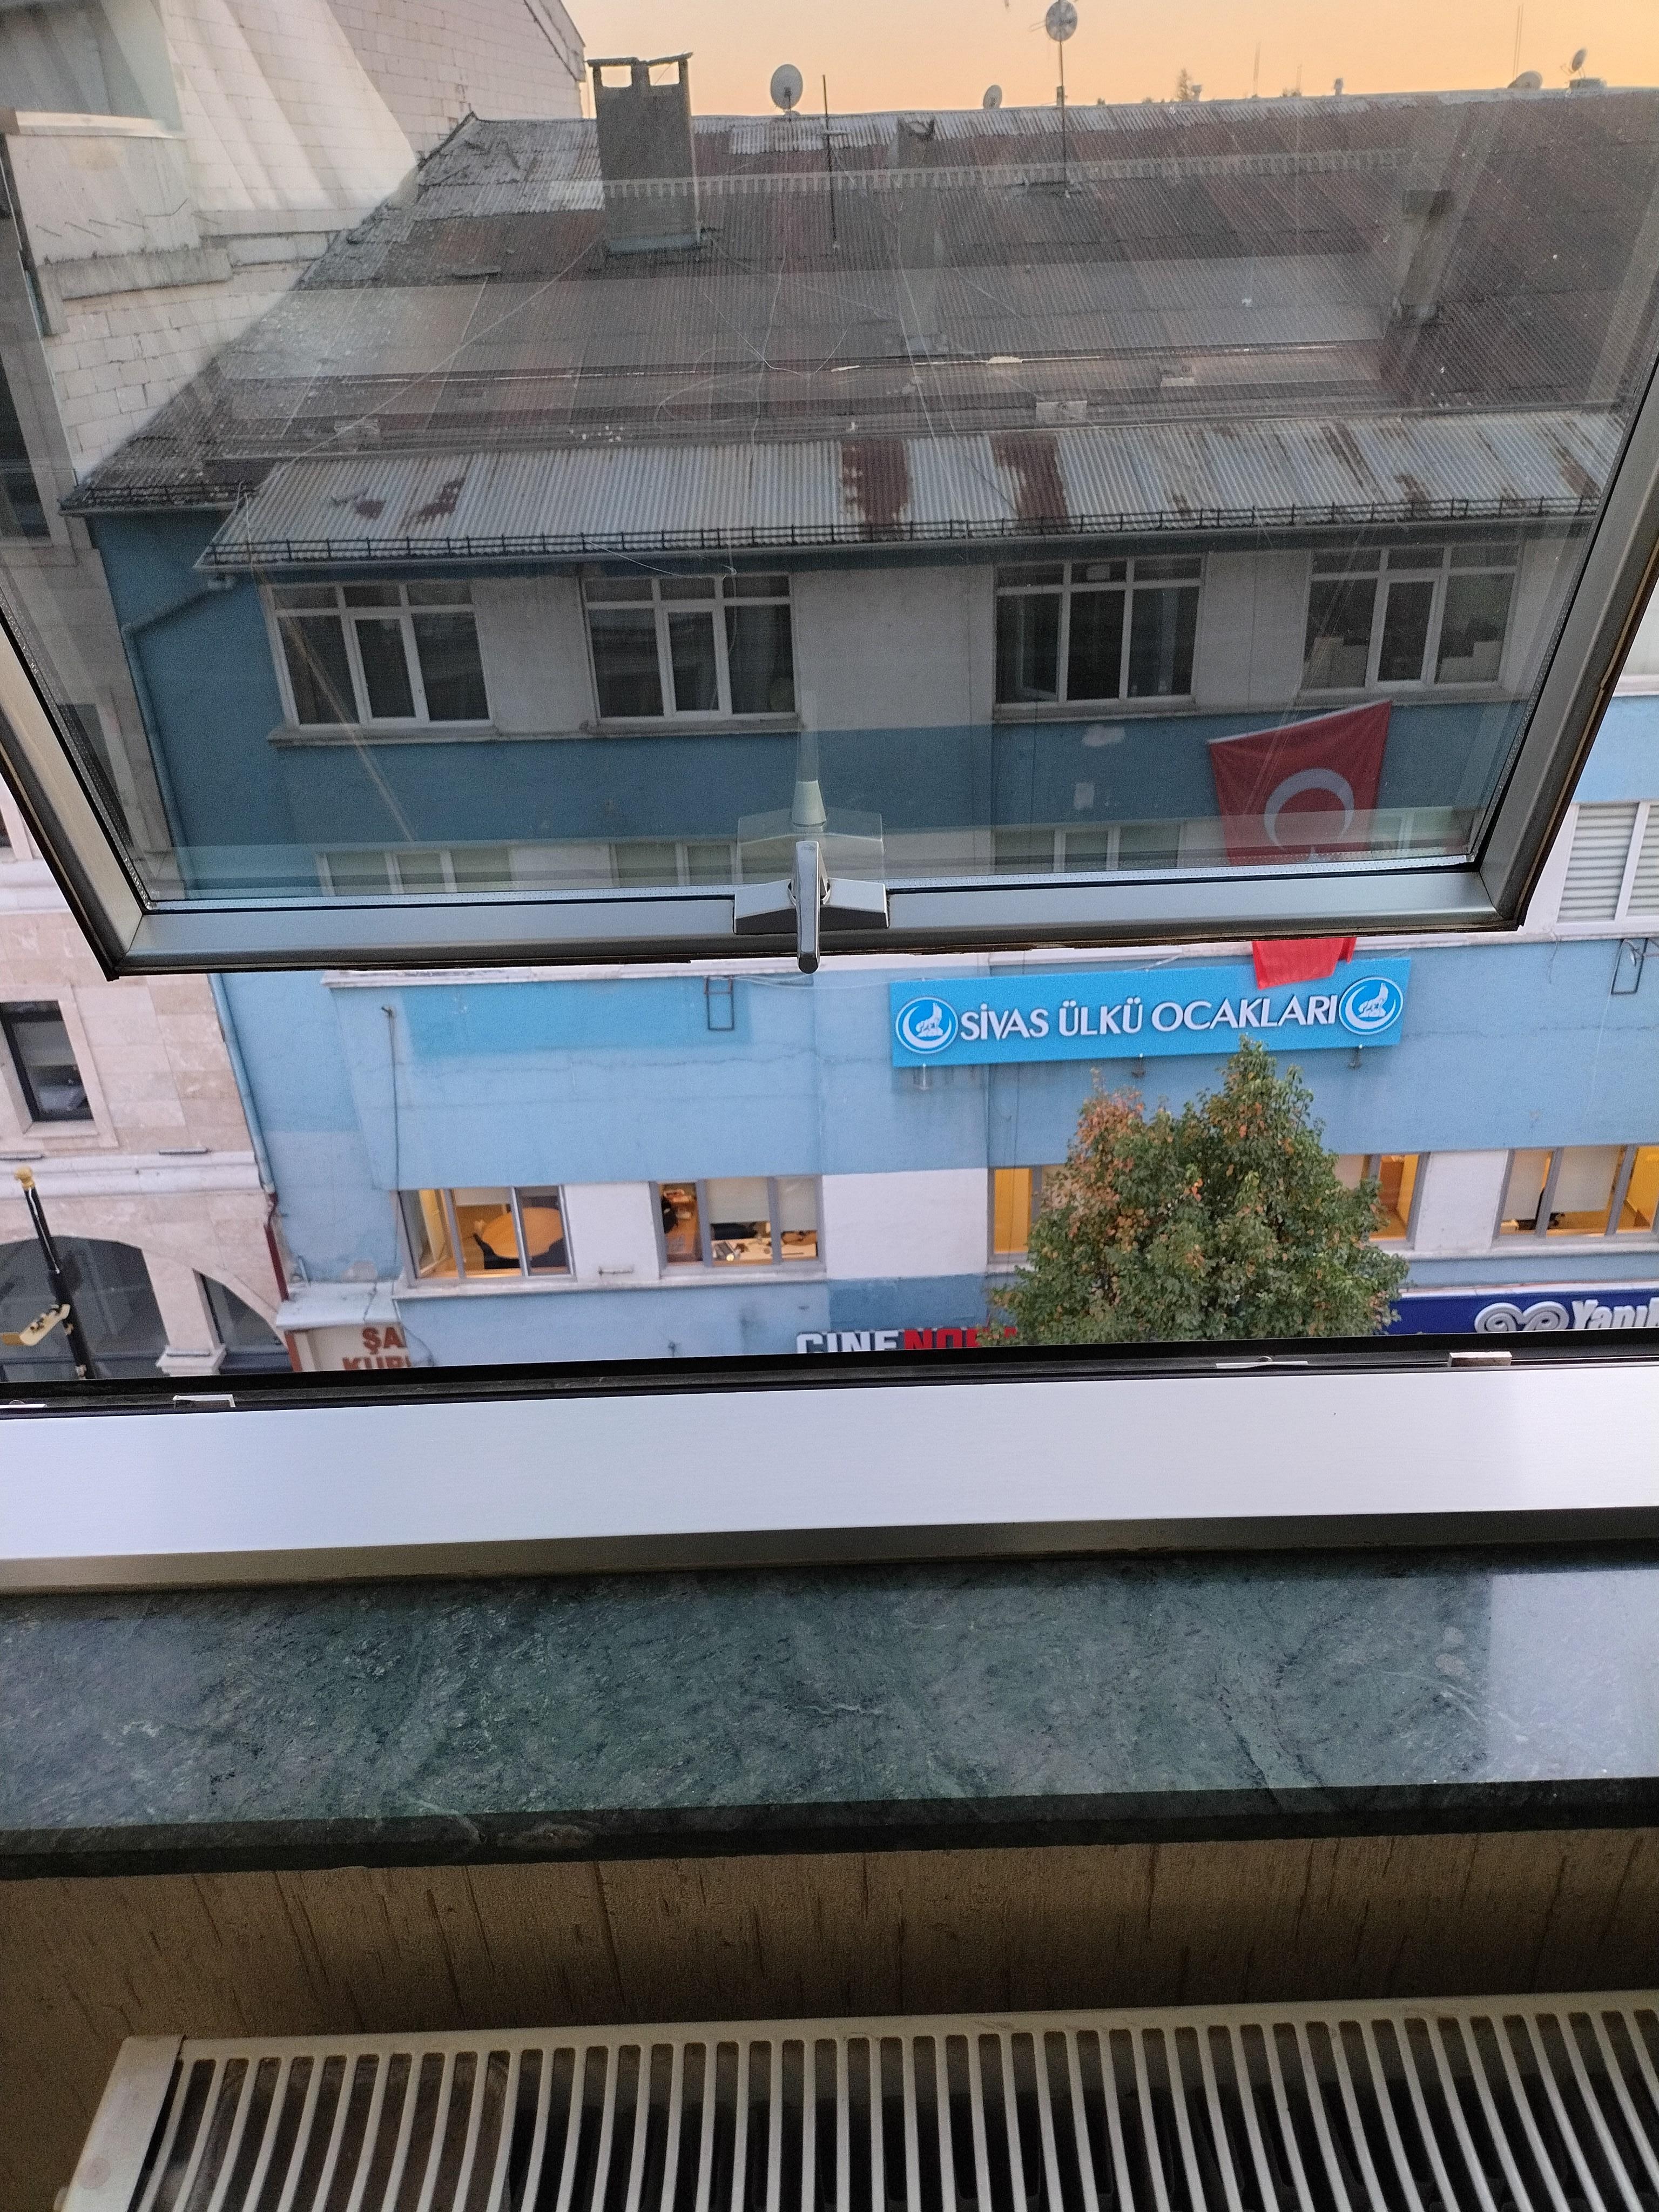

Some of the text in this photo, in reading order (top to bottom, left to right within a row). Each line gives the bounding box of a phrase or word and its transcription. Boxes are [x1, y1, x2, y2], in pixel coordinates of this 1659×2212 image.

[960, 994, 1339, 1041] SİVAS ÜLKÜ OCAKLARI
